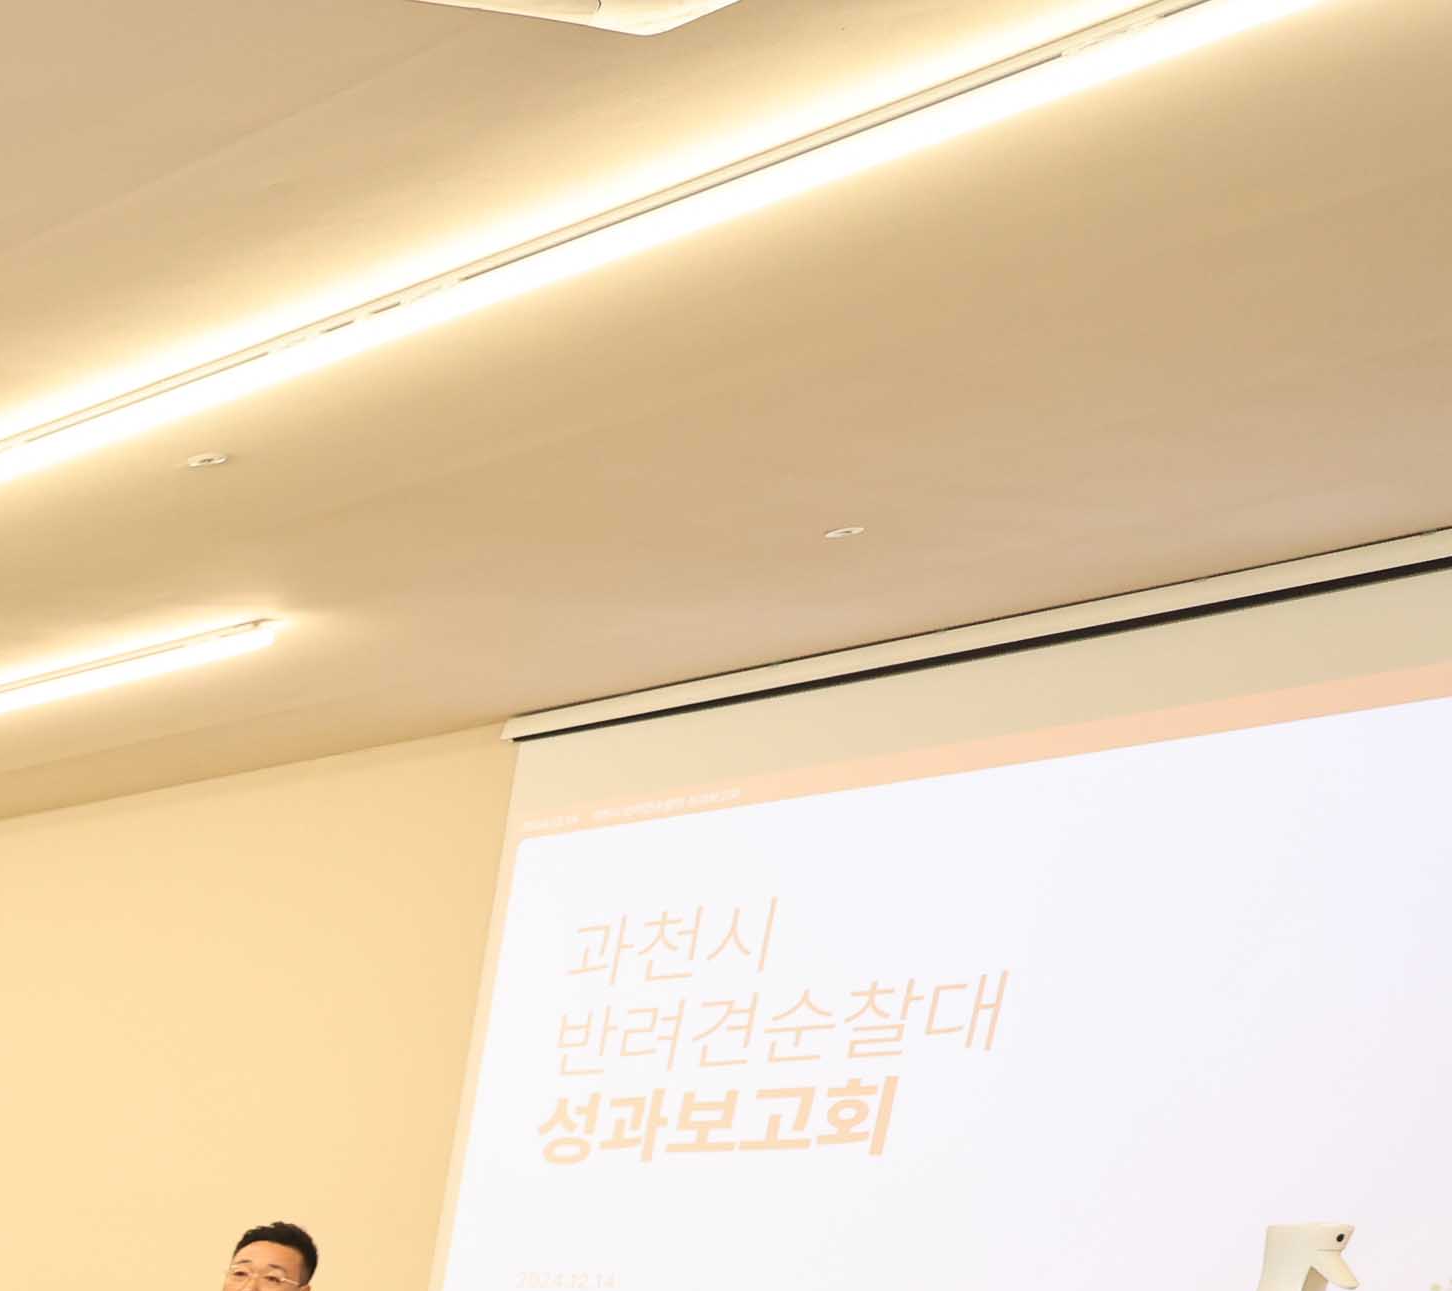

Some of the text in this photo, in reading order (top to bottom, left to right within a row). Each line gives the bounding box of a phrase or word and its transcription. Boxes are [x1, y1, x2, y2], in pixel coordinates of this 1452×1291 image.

[566, 895, 779, 986] 과천시
[554, 968, 1010, 1077] 반려견순찰대
[536, 1074, 900, 1166] 성과보고회
